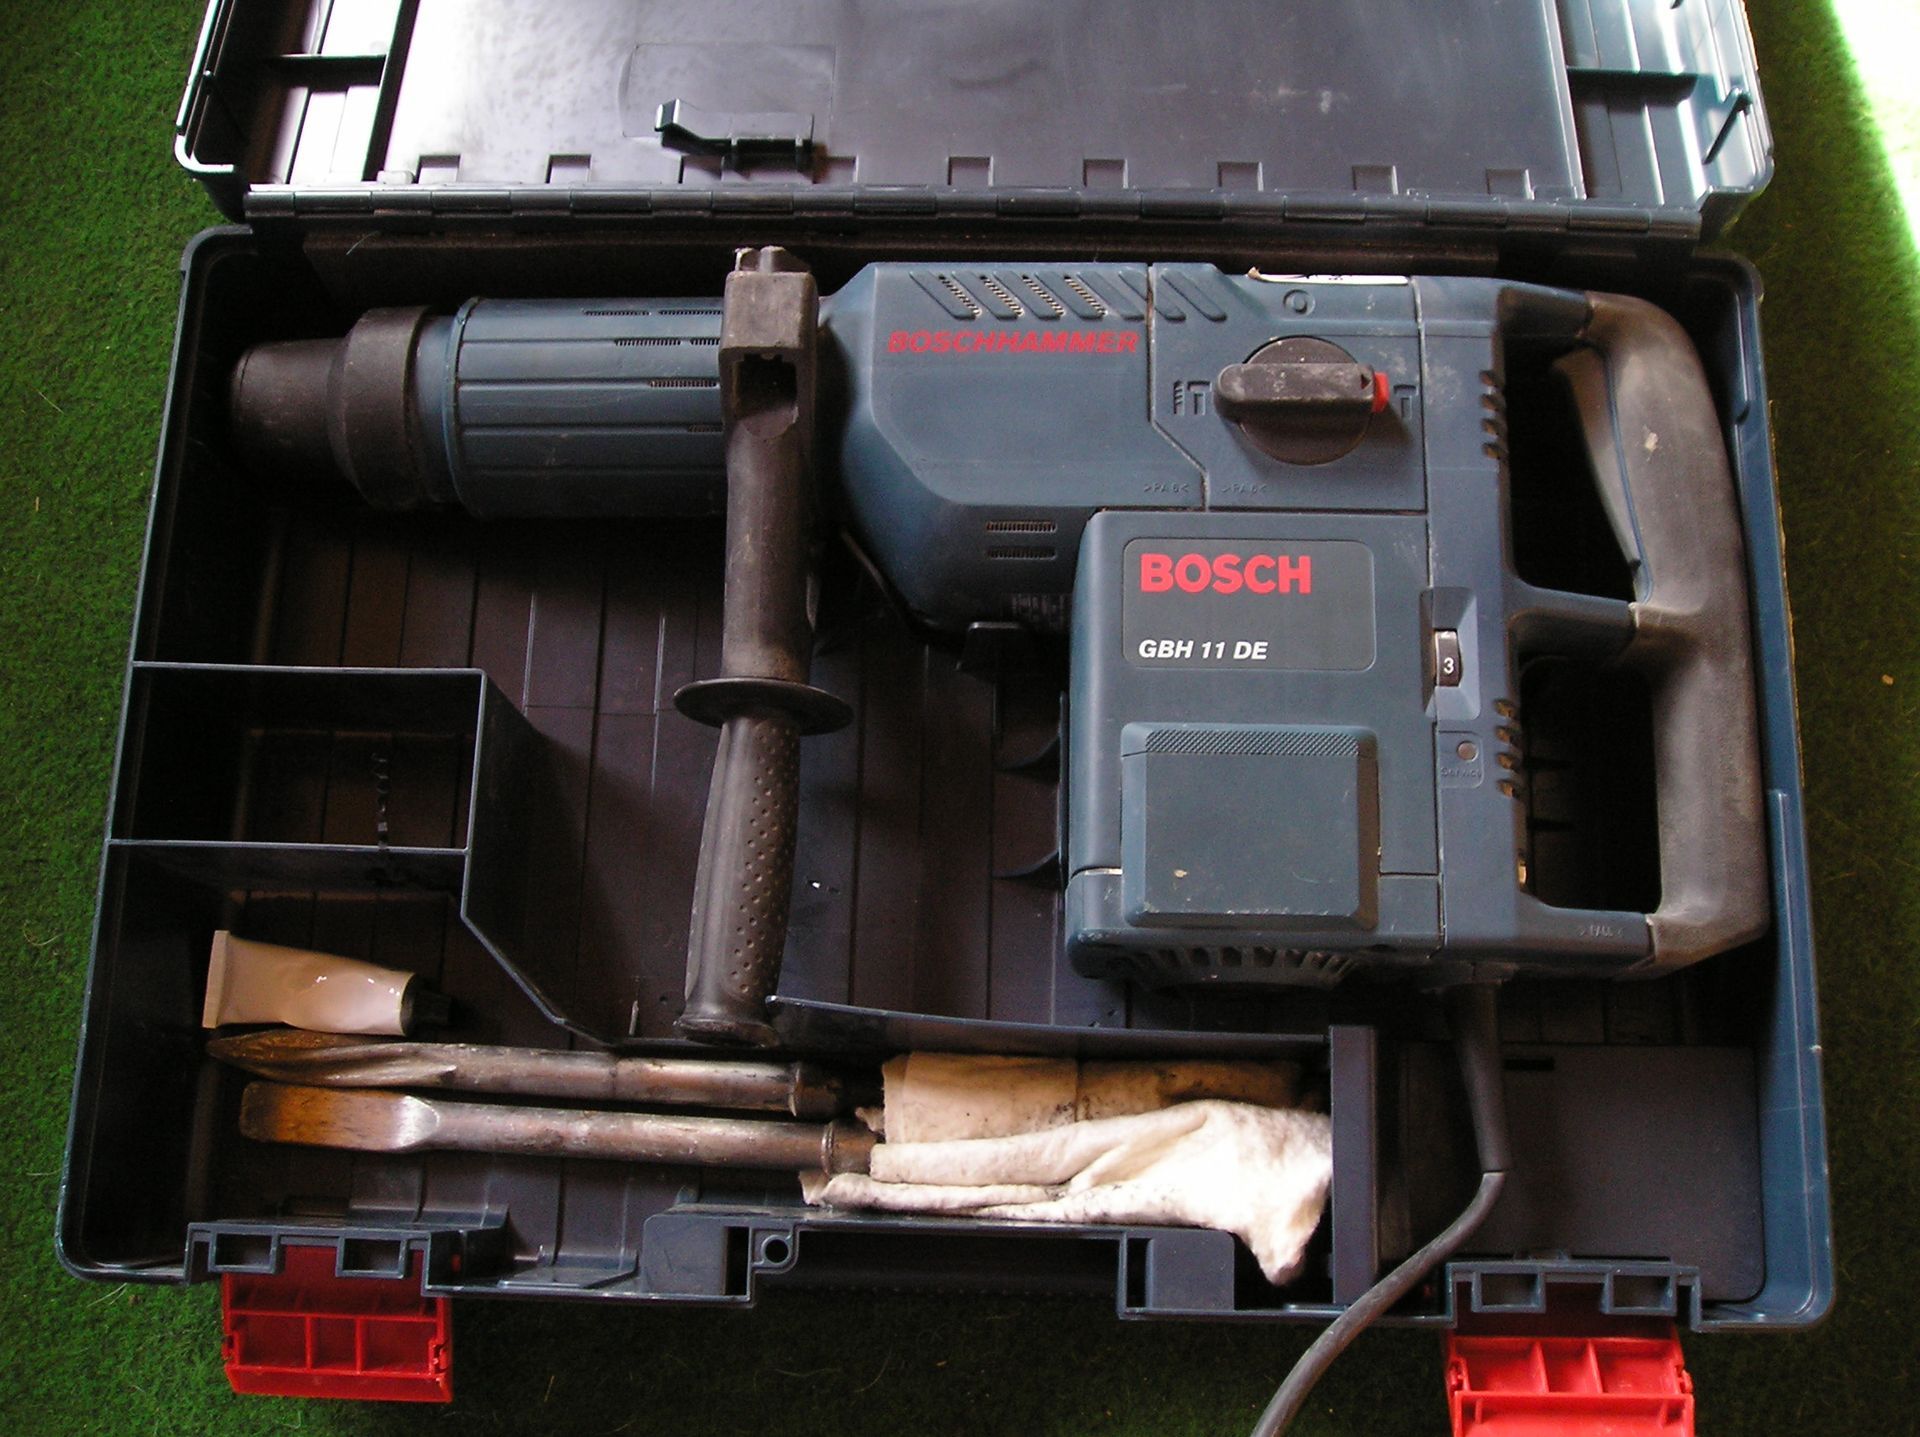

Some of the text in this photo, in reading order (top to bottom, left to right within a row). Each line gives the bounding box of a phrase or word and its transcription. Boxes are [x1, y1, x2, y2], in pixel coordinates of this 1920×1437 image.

[887, 331, 1139, 353] BOSCHHAMMER
[1140, 554, 1311, 595] BOSCH
[1138, 639, 1269, 660] GBH 11 DE
[1443, 656, 1454, 675] 3
